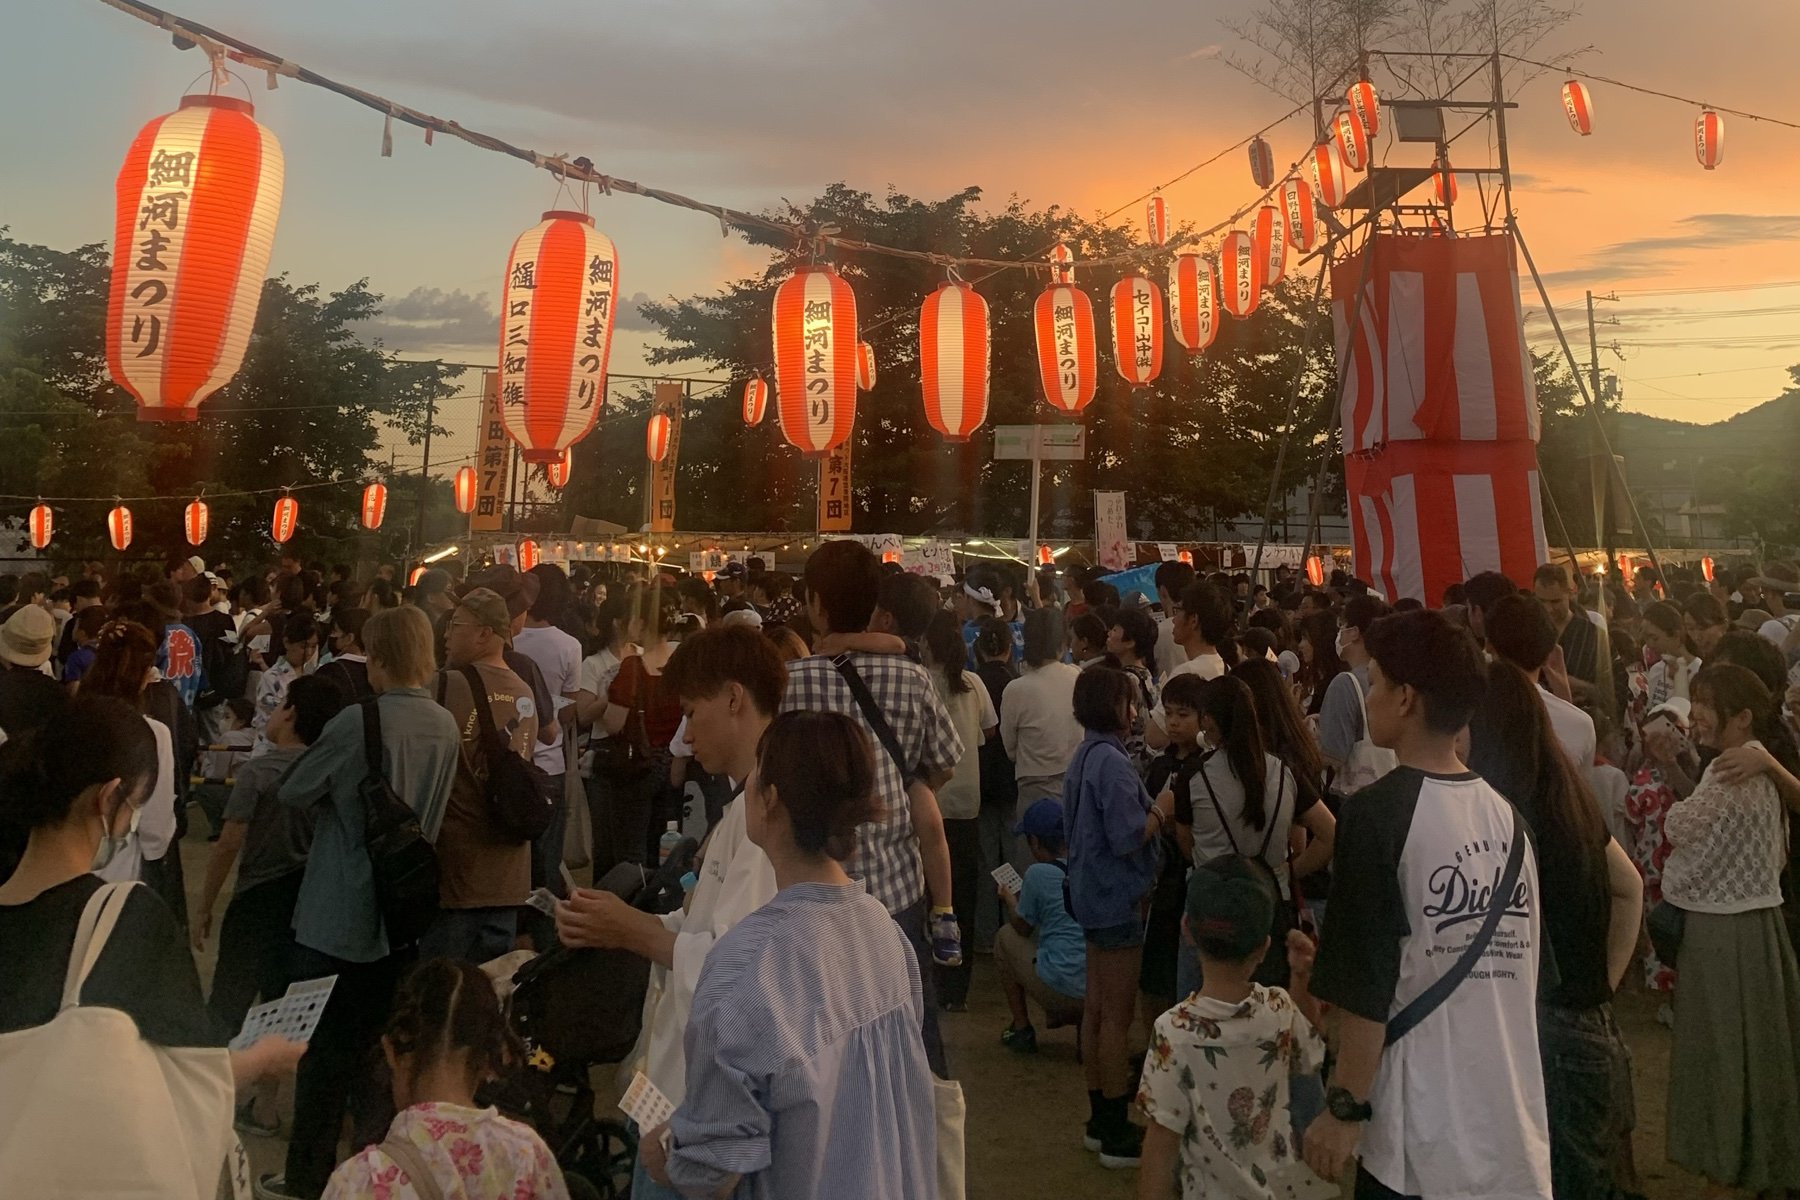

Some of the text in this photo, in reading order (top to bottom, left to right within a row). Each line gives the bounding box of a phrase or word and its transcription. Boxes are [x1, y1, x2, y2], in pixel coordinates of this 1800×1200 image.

[131, 148, 196, 358] 細河まつり
[1197, 270, 1211, 334] 細河まつり
[1238, 245, 1250, 301] 細河まつり
[502, 261, 538, 408] 樋口三知雄
[577, 254, 614, 411] 細河まつり
[803, 299, 832, 426] 細河まつり
[1053, 305, 1077, 391] 細河まつり
[494, 692, 515, 704] been
